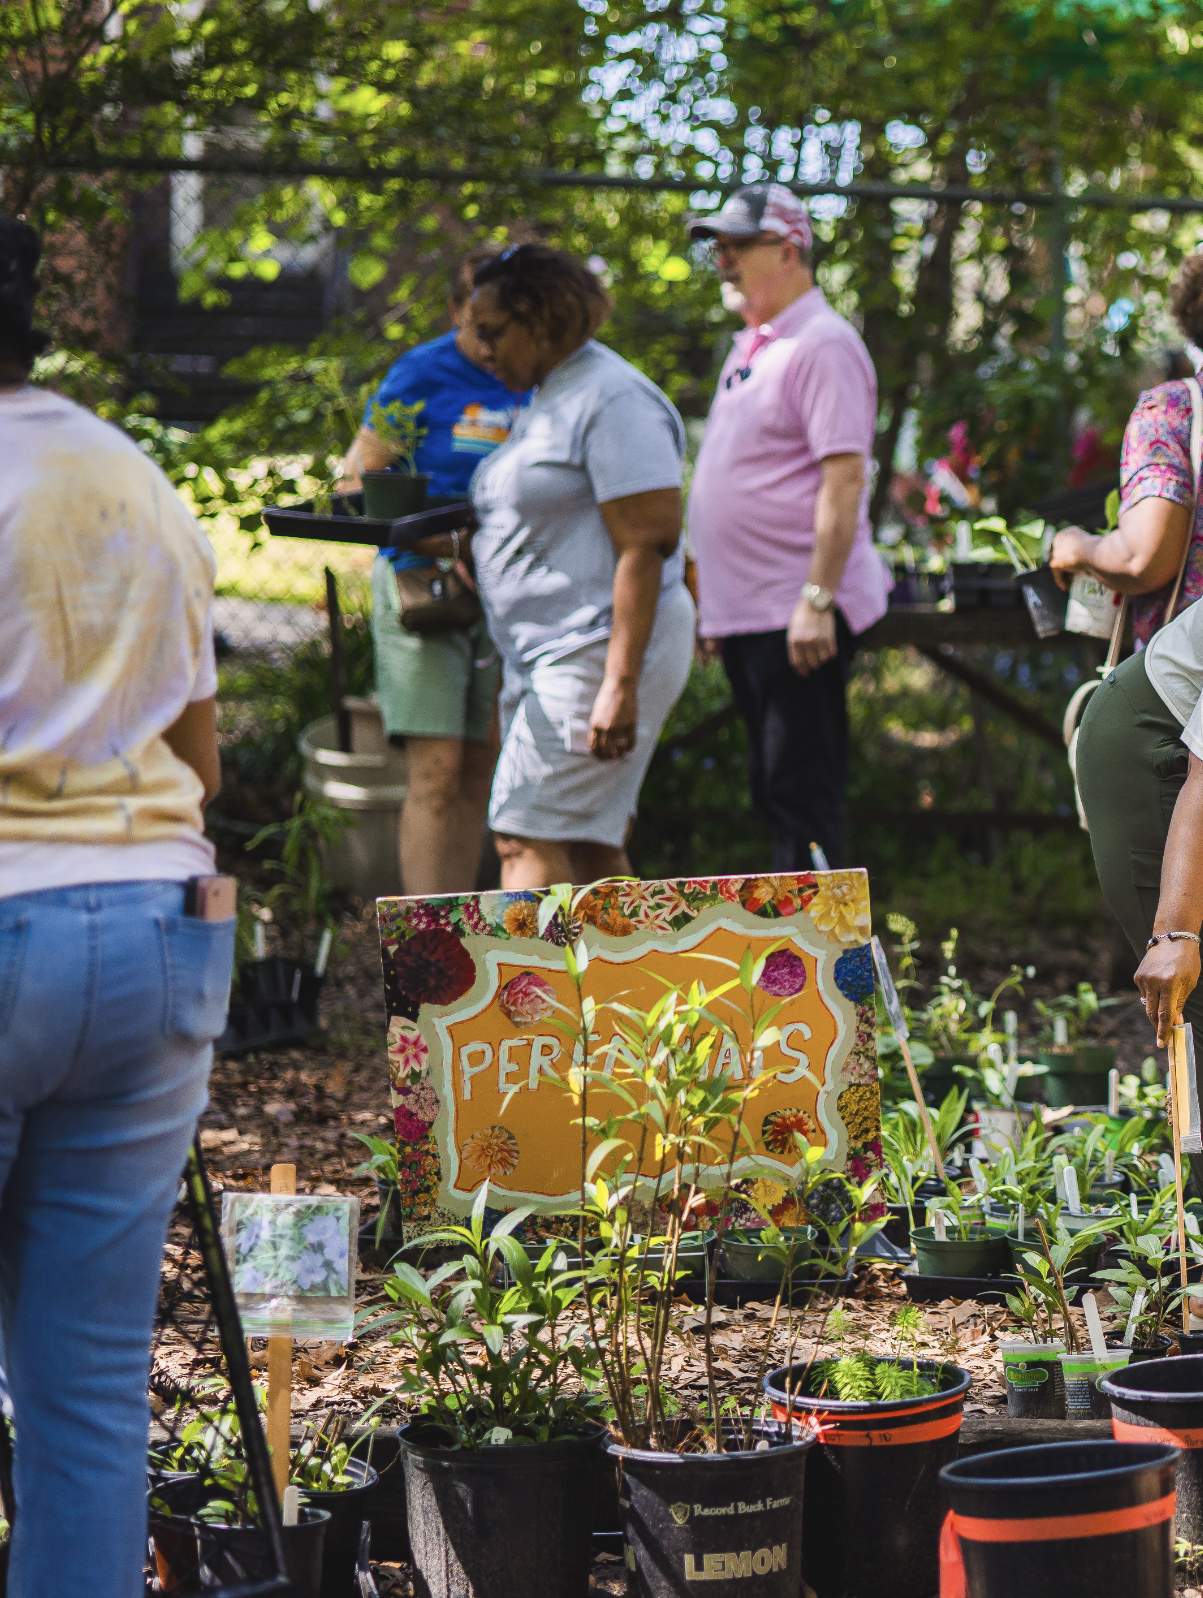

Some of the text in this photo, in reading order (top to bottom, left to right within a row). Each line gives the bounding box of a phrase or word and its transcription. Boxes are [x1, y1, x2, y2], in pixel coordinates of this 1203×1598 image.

[693, 1502, 735, 1517] Record
[737, 1500, 765, 1514] Buck
[684, 1543, 788, 1580] LEMON
